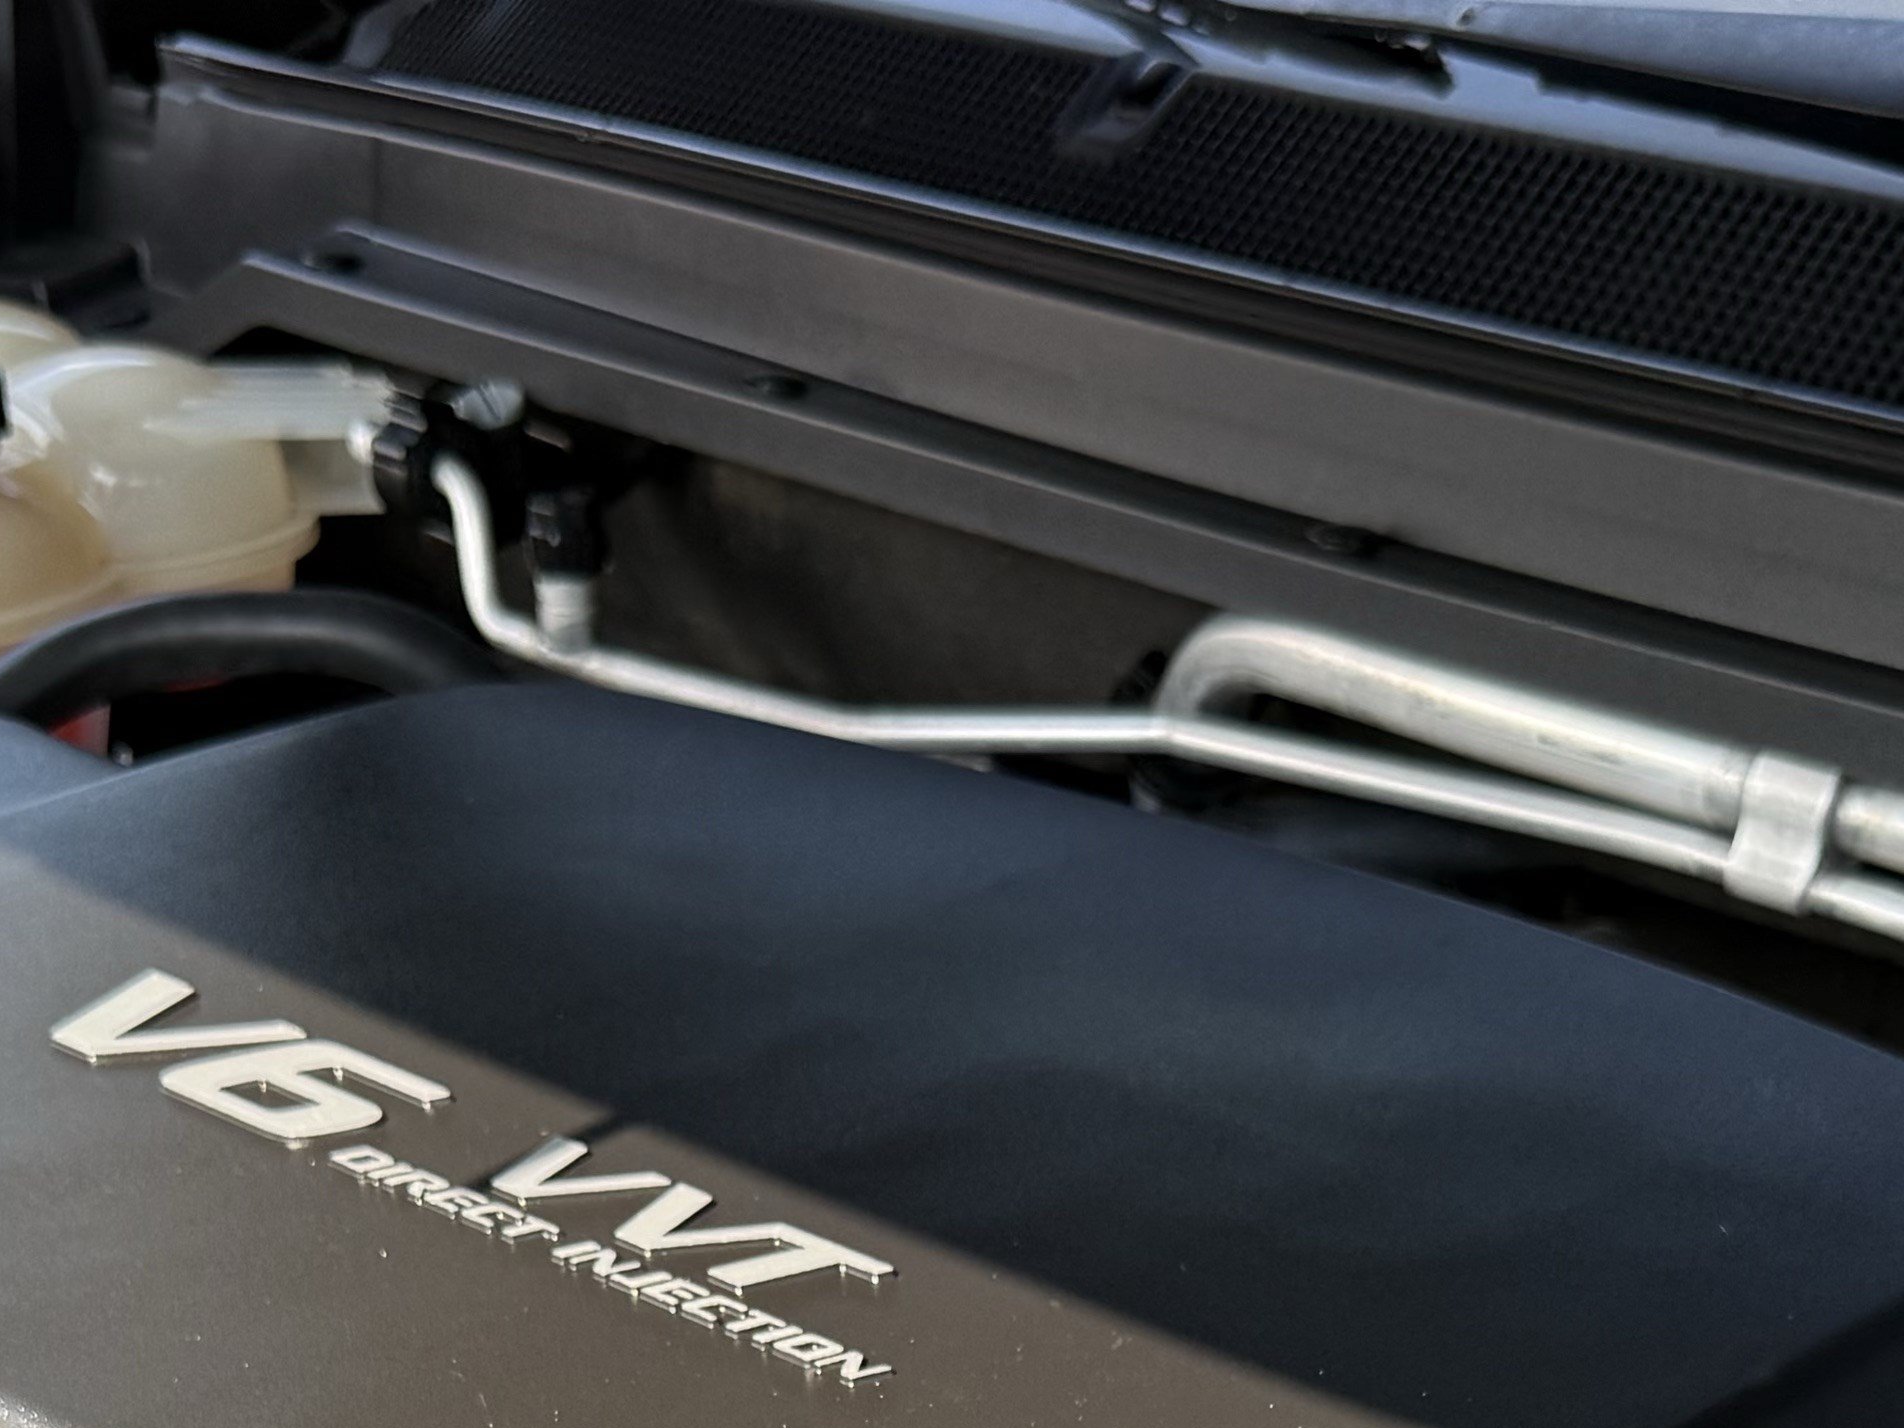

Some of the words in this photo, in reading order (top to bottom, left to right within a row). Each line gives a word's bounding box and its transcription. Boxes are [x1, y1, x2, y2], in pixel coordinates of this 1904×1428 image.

[50, 968, 451, 1141] V6
[494, 1137, 893, 1291] VVT
[328, 1144, 559, 1240] DIRECT
[552, 1241, 892, 1384] INJECTION
